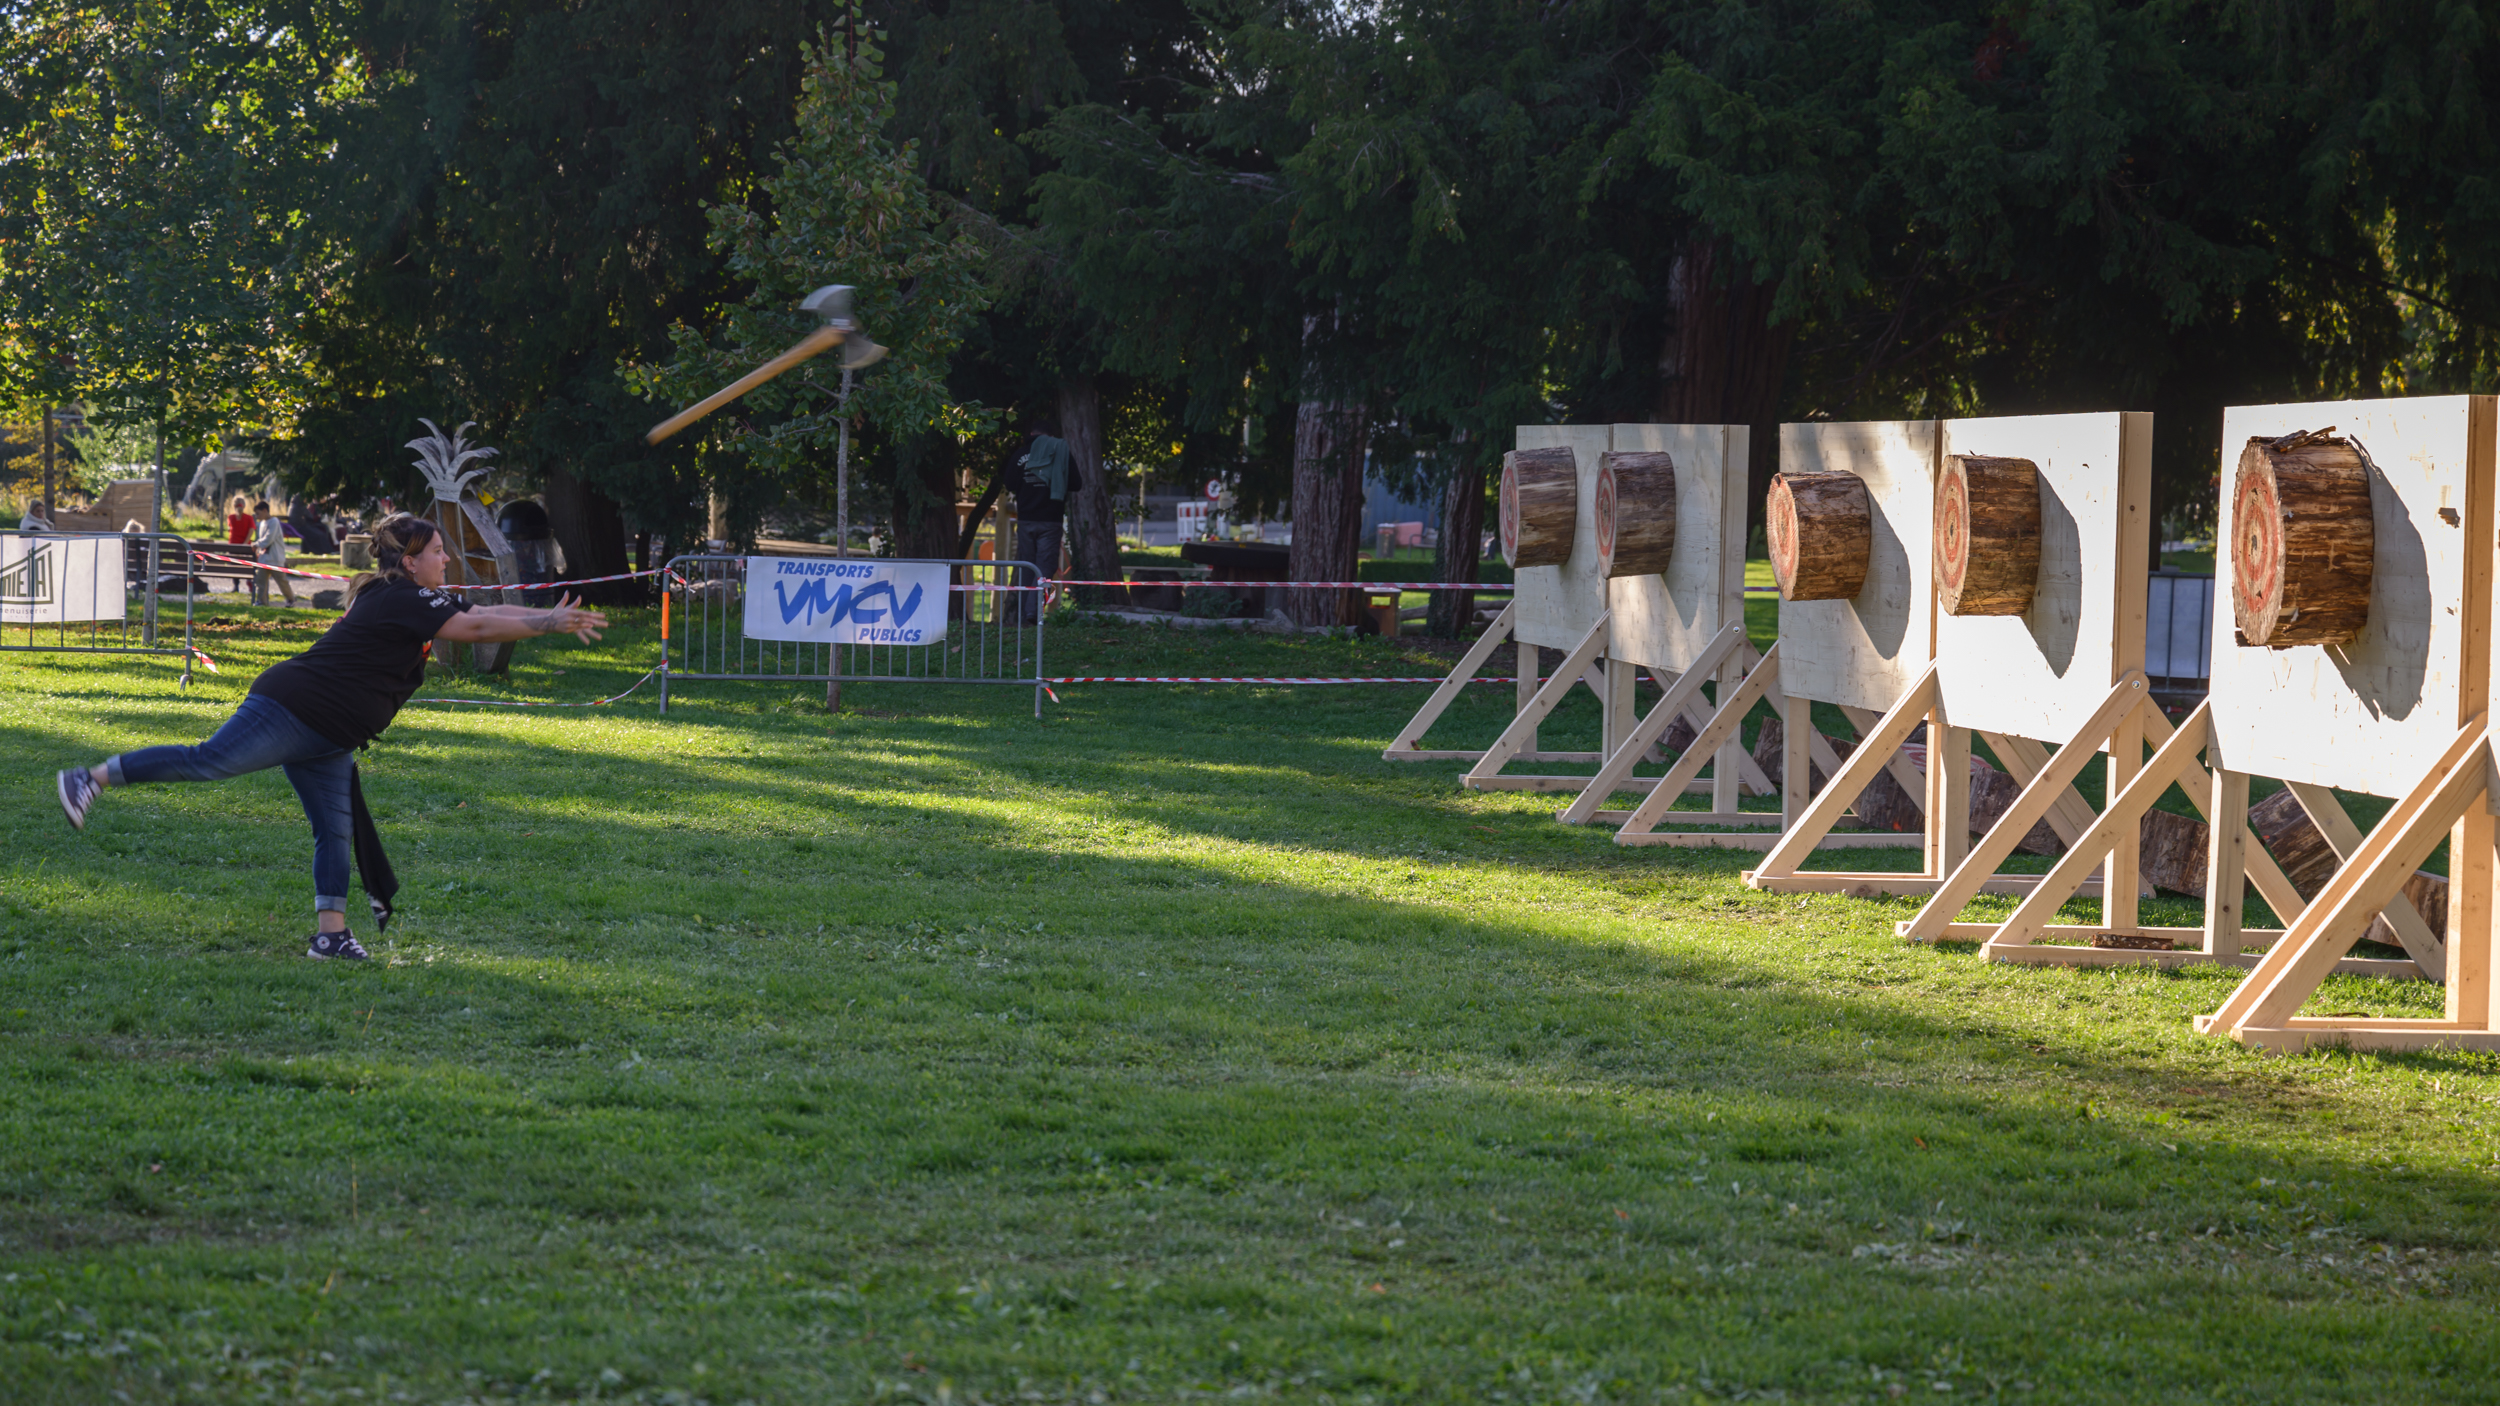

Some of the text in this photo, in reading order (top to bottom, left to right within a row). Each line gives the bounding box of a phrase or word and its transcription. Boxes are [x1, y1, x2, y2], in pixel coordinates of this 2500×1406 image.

[776, 561, 874, 578] TRANSPORTS
[773, 578, 924, 629] VMCV
[858, 628, 922, 642] PUBLICS
